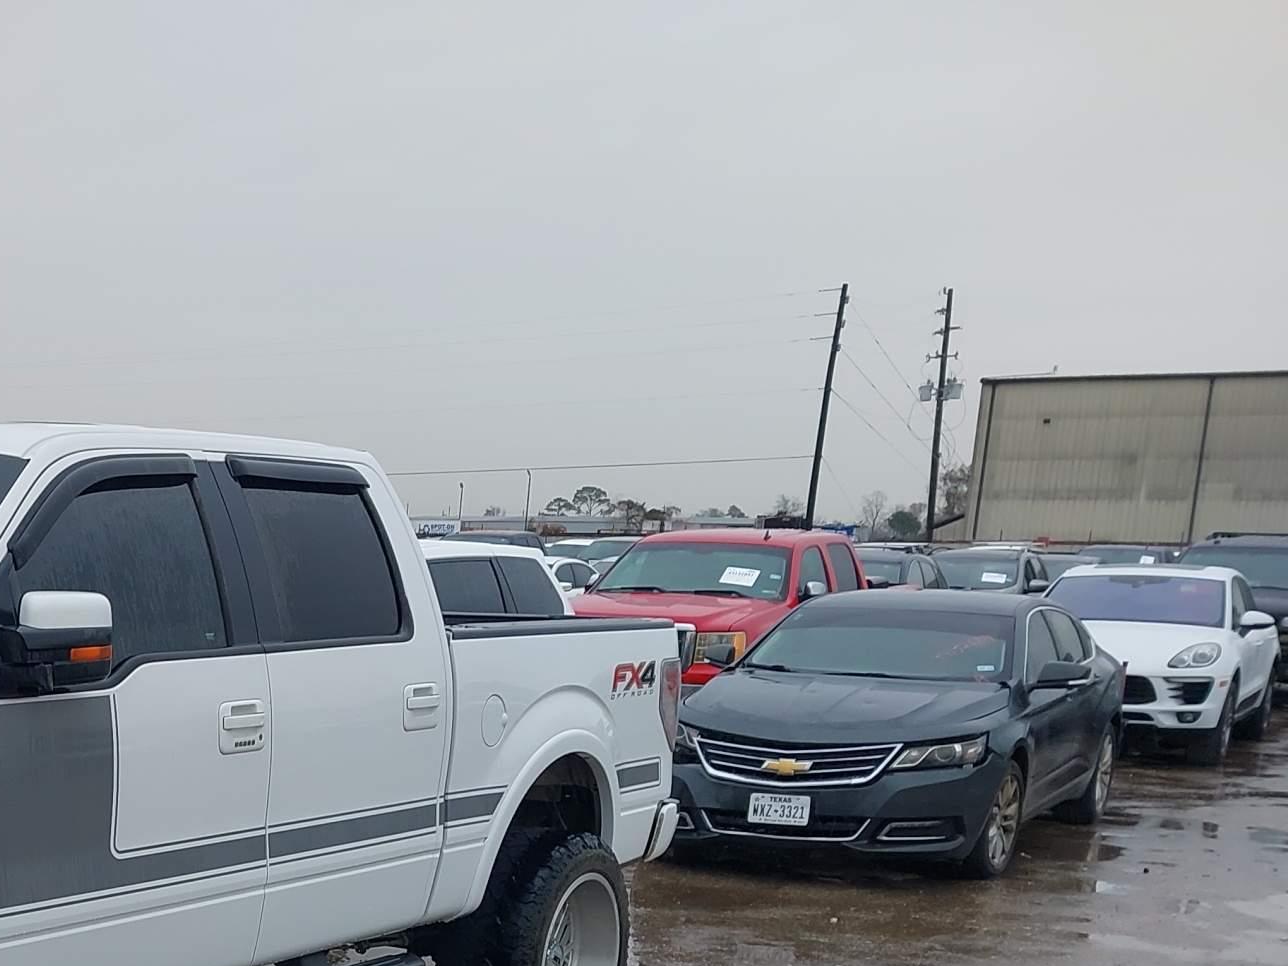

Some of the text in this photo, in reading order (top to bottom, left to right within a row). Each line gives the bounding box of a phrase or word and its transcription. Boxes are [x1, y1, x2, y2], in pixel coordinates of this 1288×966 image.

[611, 660, 657, 692] FX4
[610, 688, 655, 701] OFF ROAD
[769, 796, 792, 804] TEXAS
